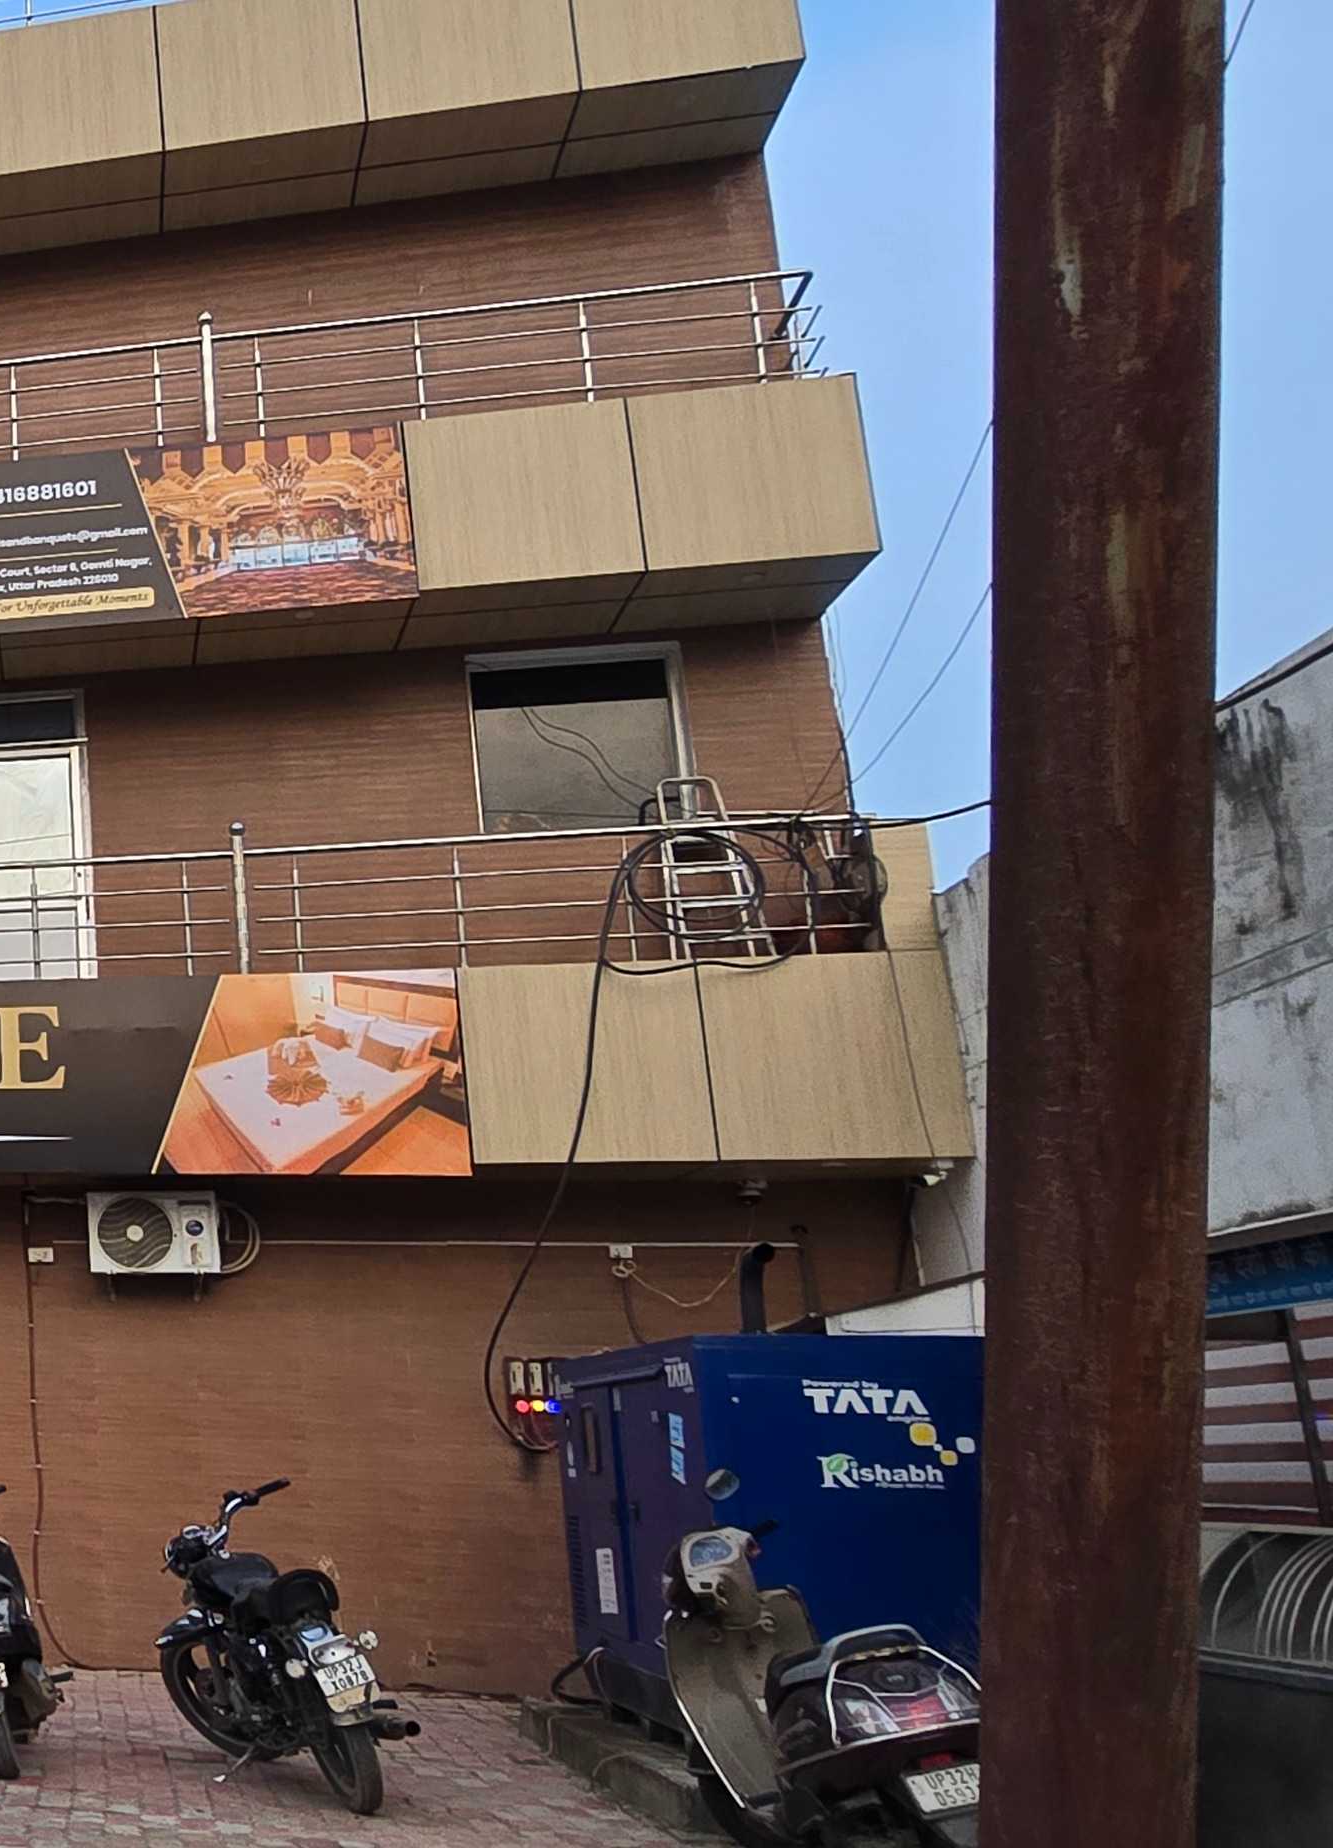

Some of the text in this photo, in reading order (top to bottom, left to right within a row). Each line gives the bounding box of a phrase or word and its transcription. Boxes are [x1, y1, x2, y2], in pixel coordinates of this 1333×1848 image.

[33, 564, 68, 575] Sector
[36, 576, 82, 589] Pradesh
[16, 594, 94, 614] Unforgettable
[95, 591, 150, 607] Moments
[801, 1378, 880, 1390] Powered by
[803, 1388, 930, 1415] TATA
[816, 1453, 945, 1489] Rishabh
